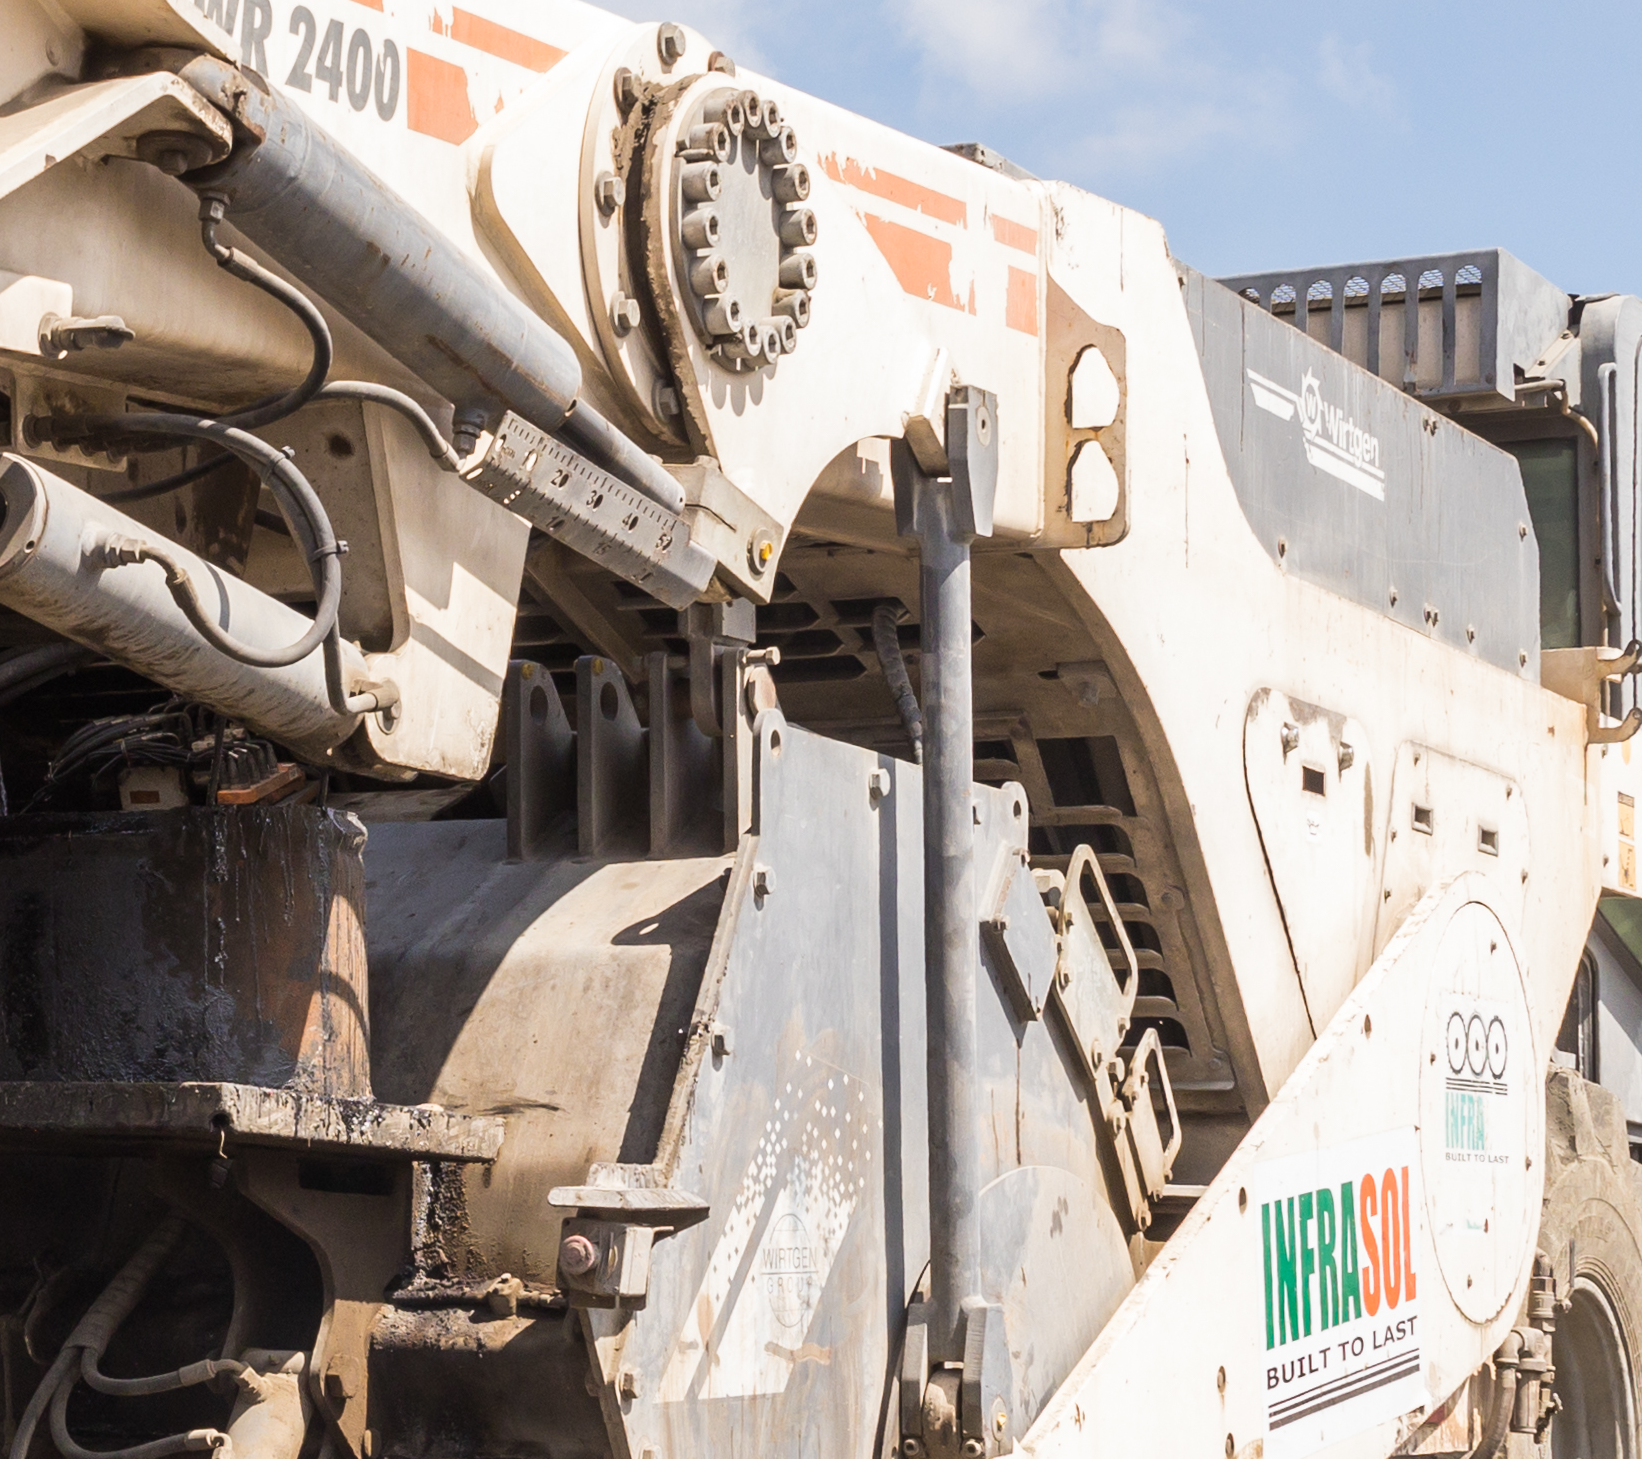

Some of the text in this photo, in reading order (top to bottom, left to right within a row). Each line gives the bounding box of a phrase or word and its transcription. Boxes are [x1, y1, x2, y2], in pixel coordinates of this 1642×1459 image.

[285, 5, 401, 122] 2400
[1323, 401, 1380, 469] Wirtgen
[550, 469, 570, 489] 20
[586, 490, 604, 511] 30
[621, 513, 639, 533] 40
[1445, 1152, 1510, 1165] BUILT TO LAST
[762, 1246, 818, 1270] WIRTGEN
[1261, 1165, 1417, 1351] INFRASOL
[1266, 1315, 1418, 1391] BUILT TO LAST
